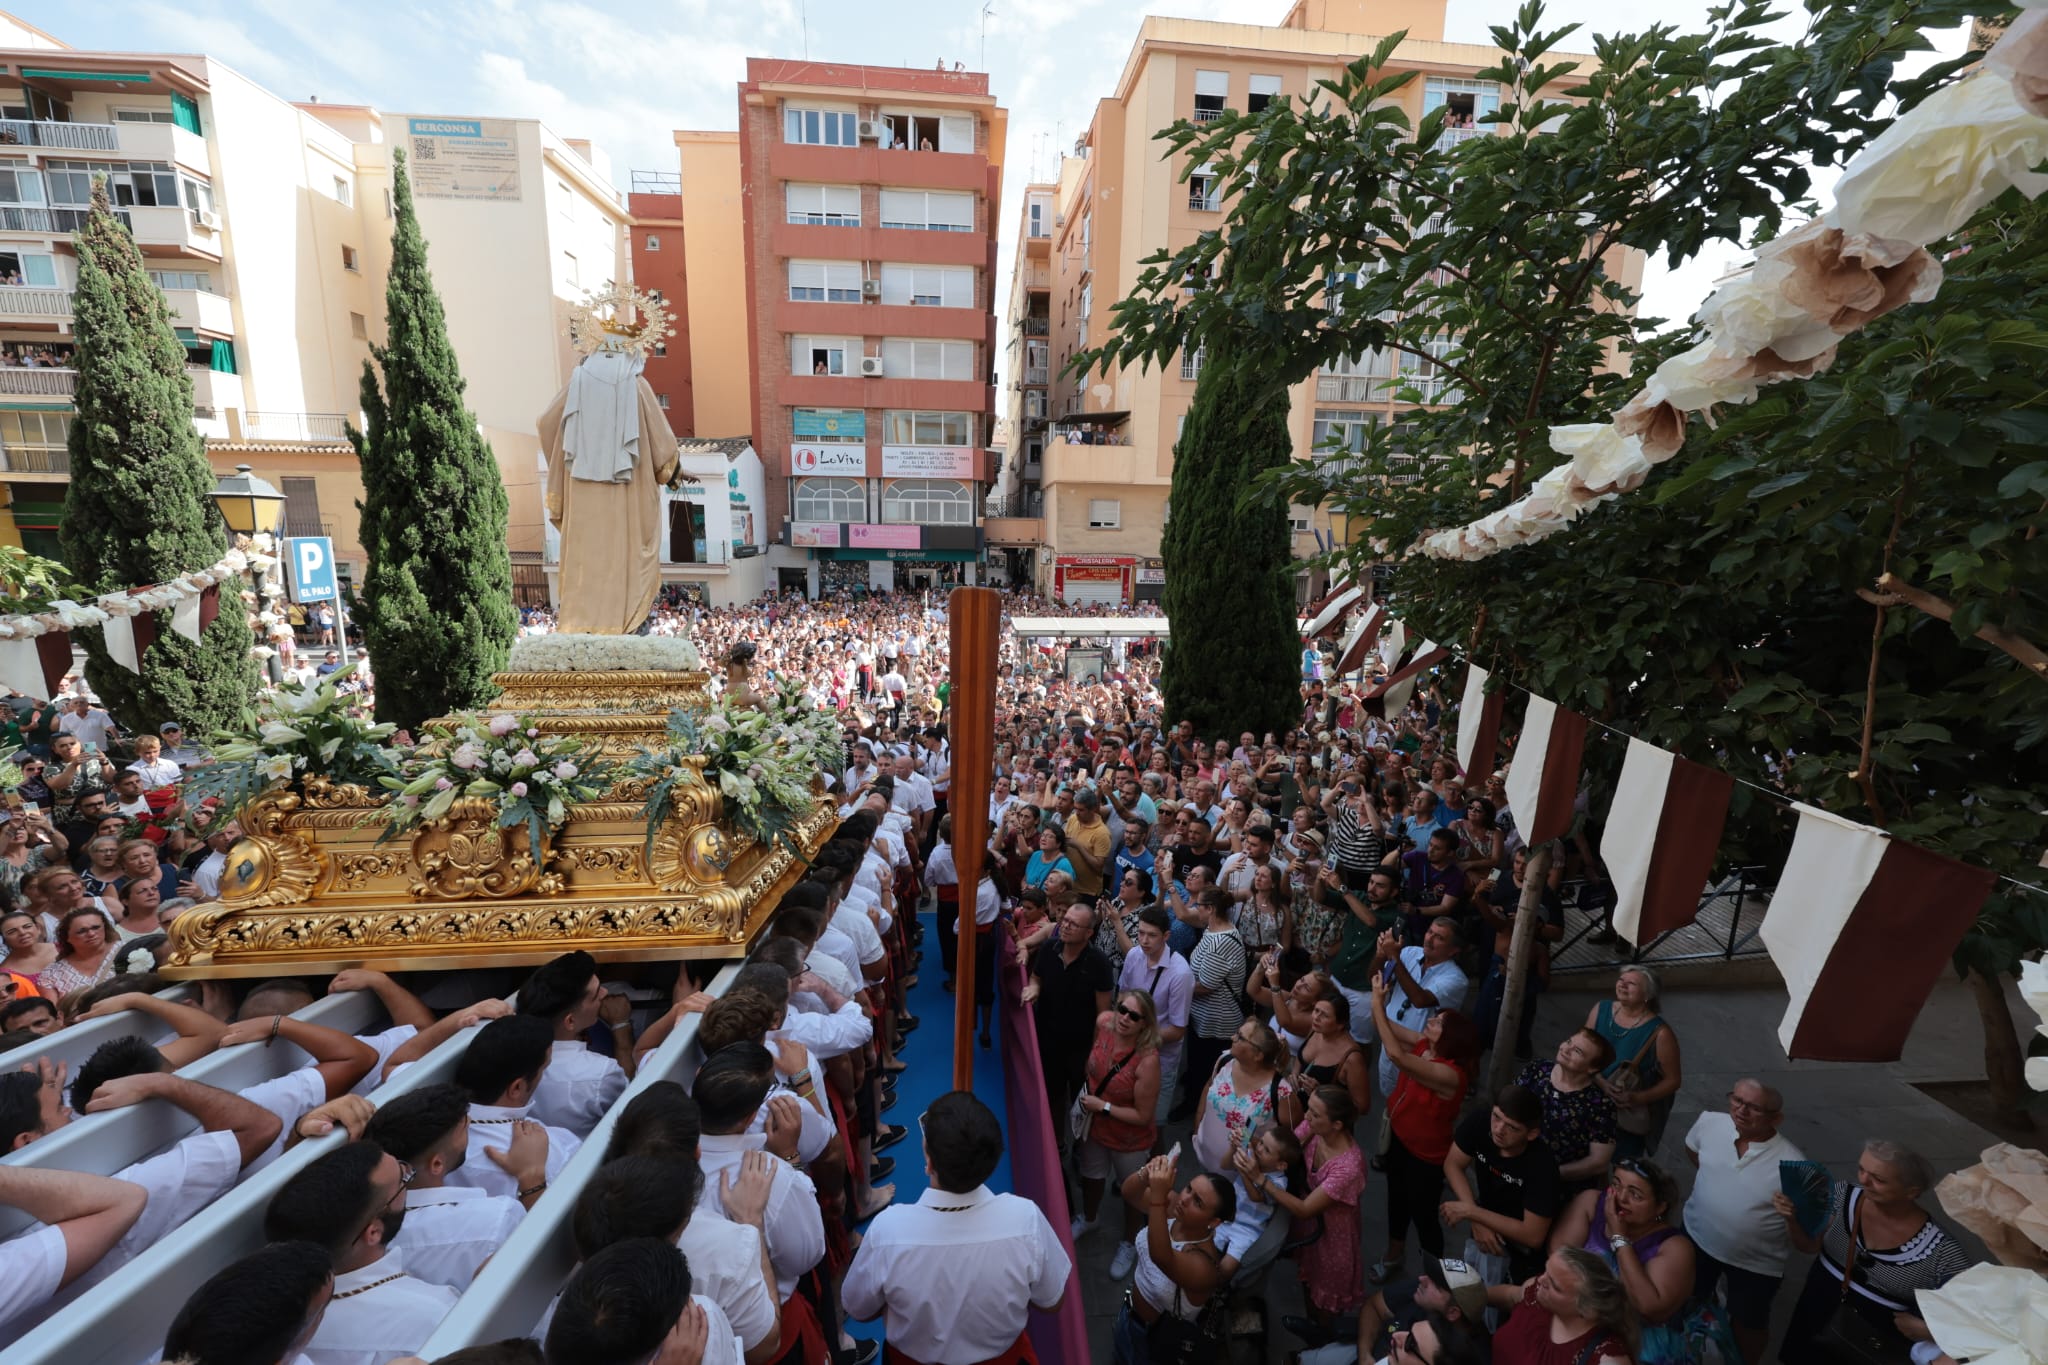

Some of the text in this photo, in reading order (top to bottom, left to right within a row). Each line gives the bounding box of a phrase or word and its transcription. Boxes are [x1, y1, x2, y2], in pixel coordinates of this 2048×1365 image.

[415, 122, 476, 134] SERCONSA
[897, 550, 927, 559] cajamar
[300, 542, 323, 585] P
[301, 586, 331, 597] EL PALO
